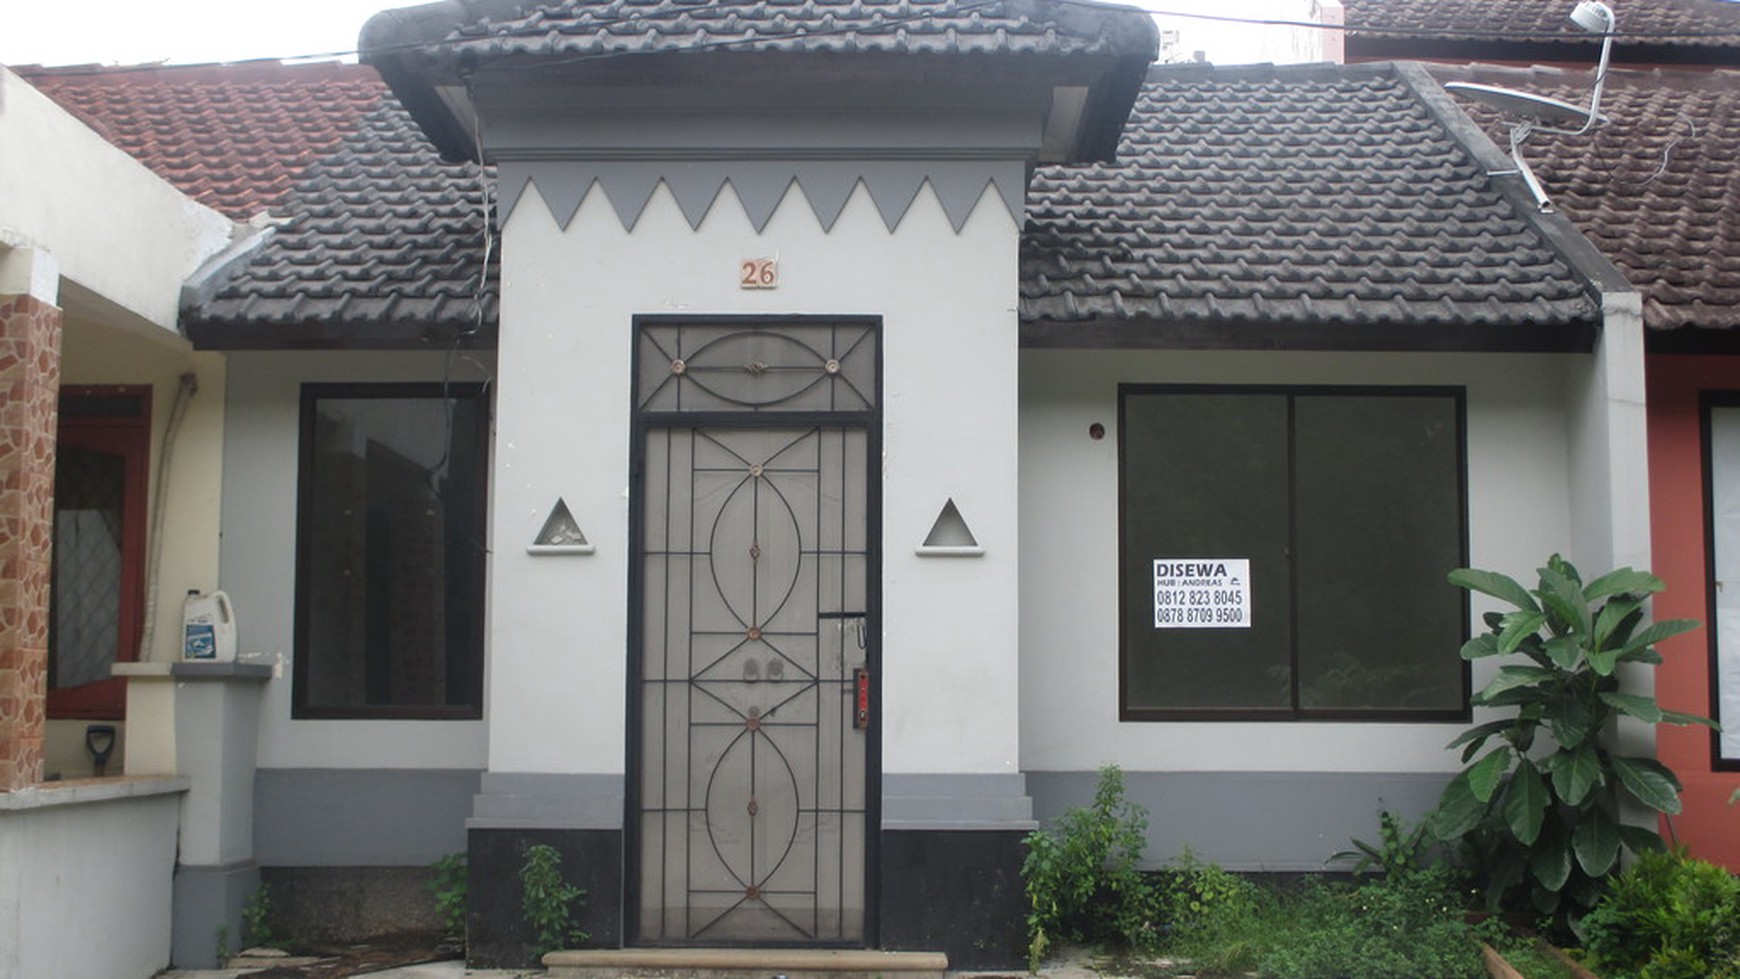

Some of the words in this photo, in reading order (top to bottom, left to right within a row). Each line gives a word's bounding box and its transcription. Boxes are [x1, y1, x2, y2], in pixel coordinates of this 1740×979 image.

[742, 261, 774, 285] 26
[1157, 564, 1227, 577] DISEWA
[1157, 590, 1186, 605] 0812
[1189, 590, 1210, 605] 823
[1213, 590, 1242, 605] 8045
[1157, 608, 1184, 622] 0878
[1187, 608, 1213, 622] 8709
[1216, 608, 1243, 622] 9500
